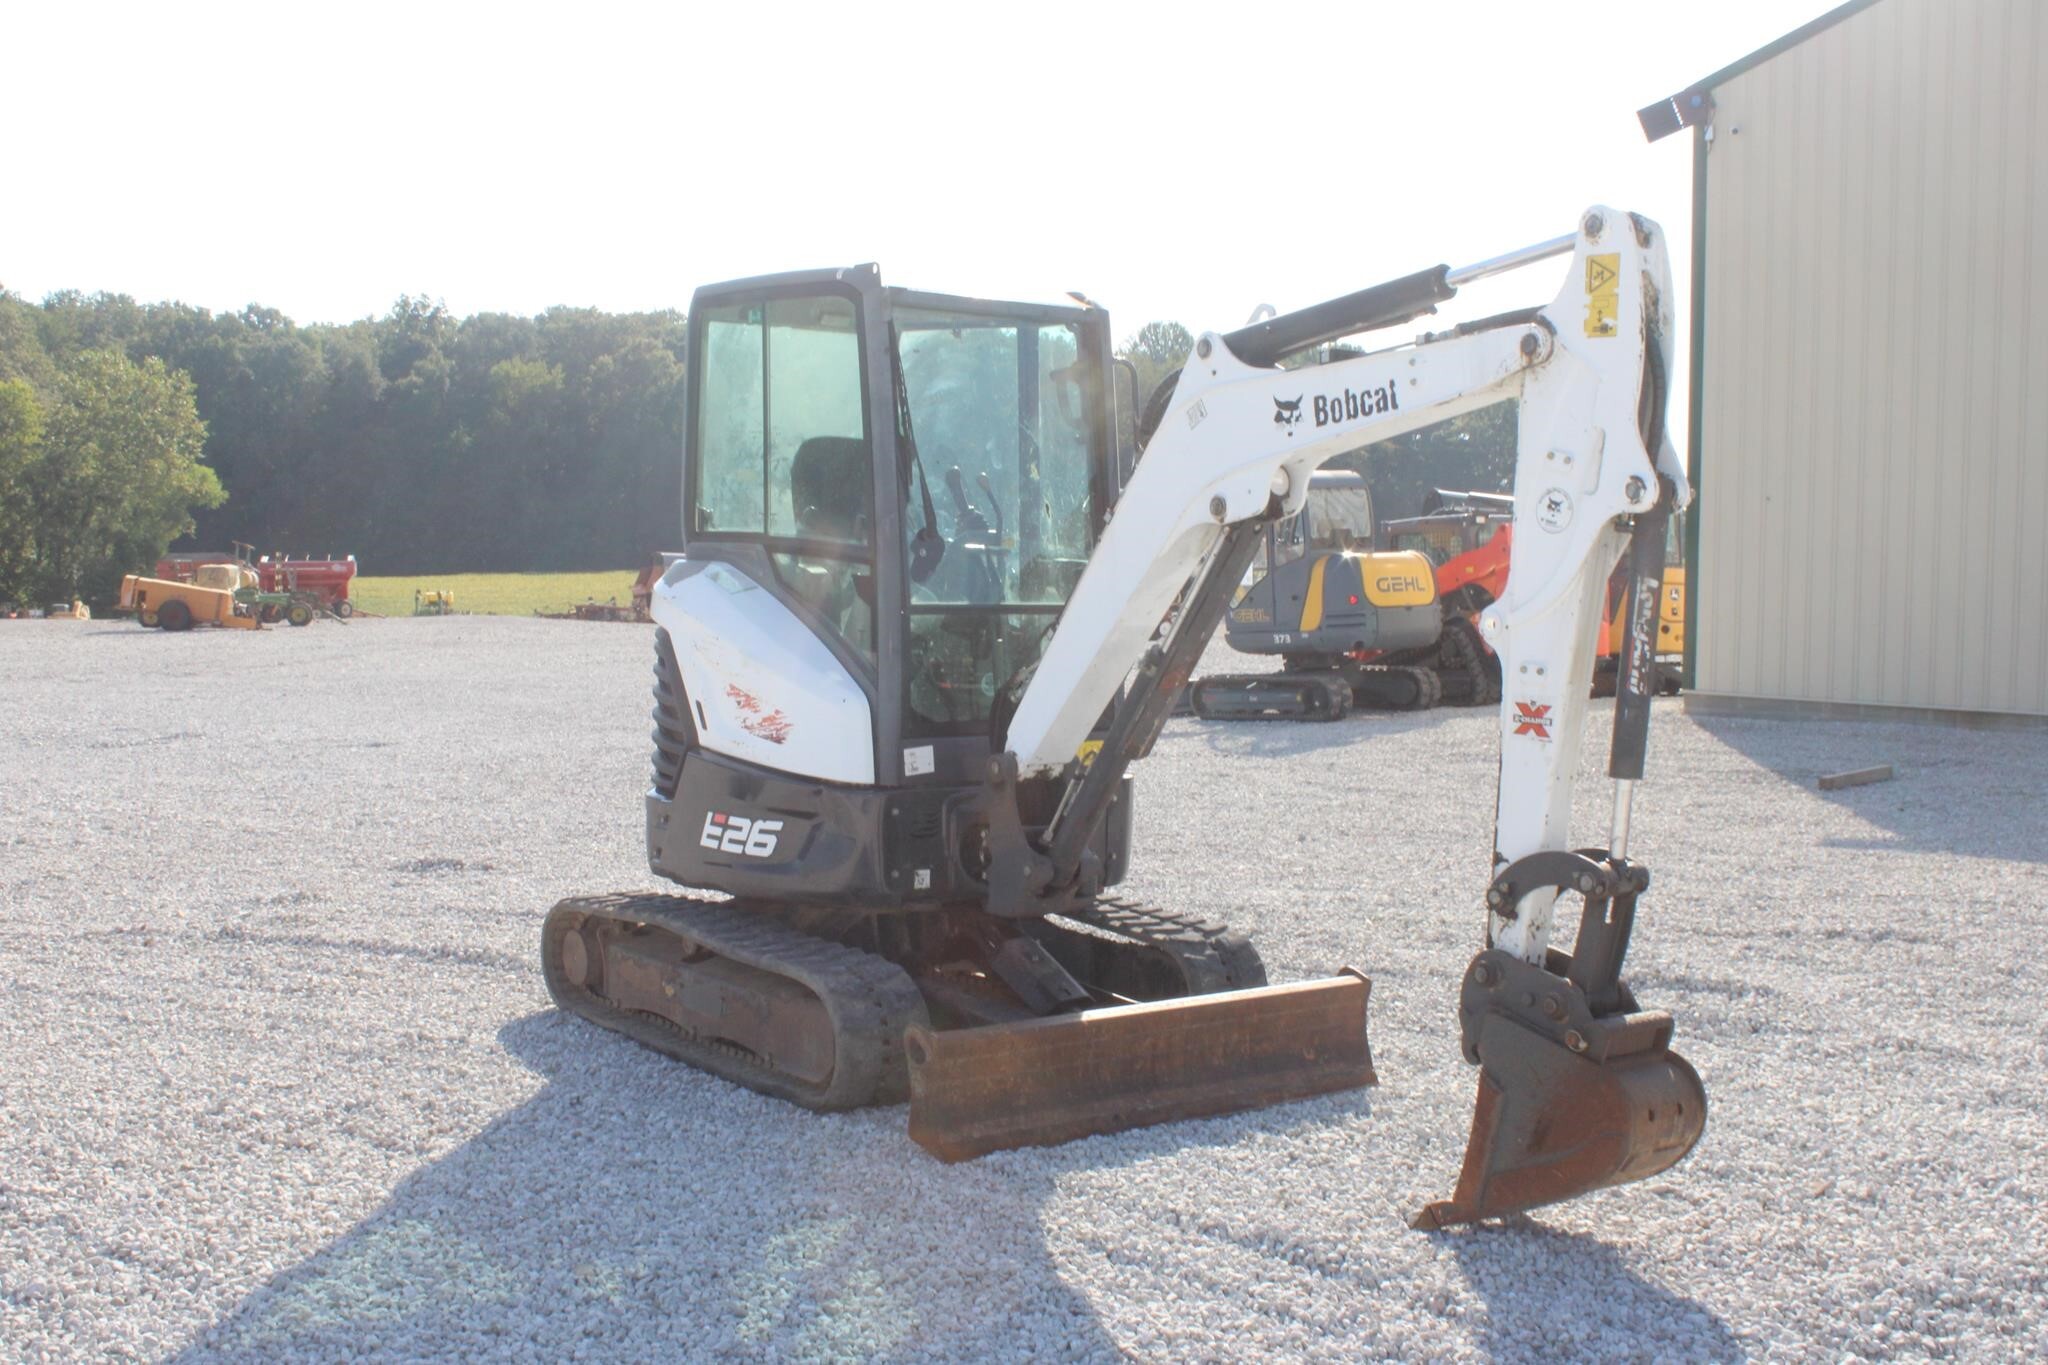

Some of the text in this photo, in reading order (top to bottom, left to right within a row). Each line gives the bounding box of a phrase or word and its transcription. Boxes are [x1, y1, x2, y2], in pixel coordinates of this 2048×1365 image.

[1314, 379, 1398, 426] Bobcat
[1375, 576, 1426, 593] GEHL
[1232, 607, 1271, 624] GEHL
[700, 812, 783, 857] E26
